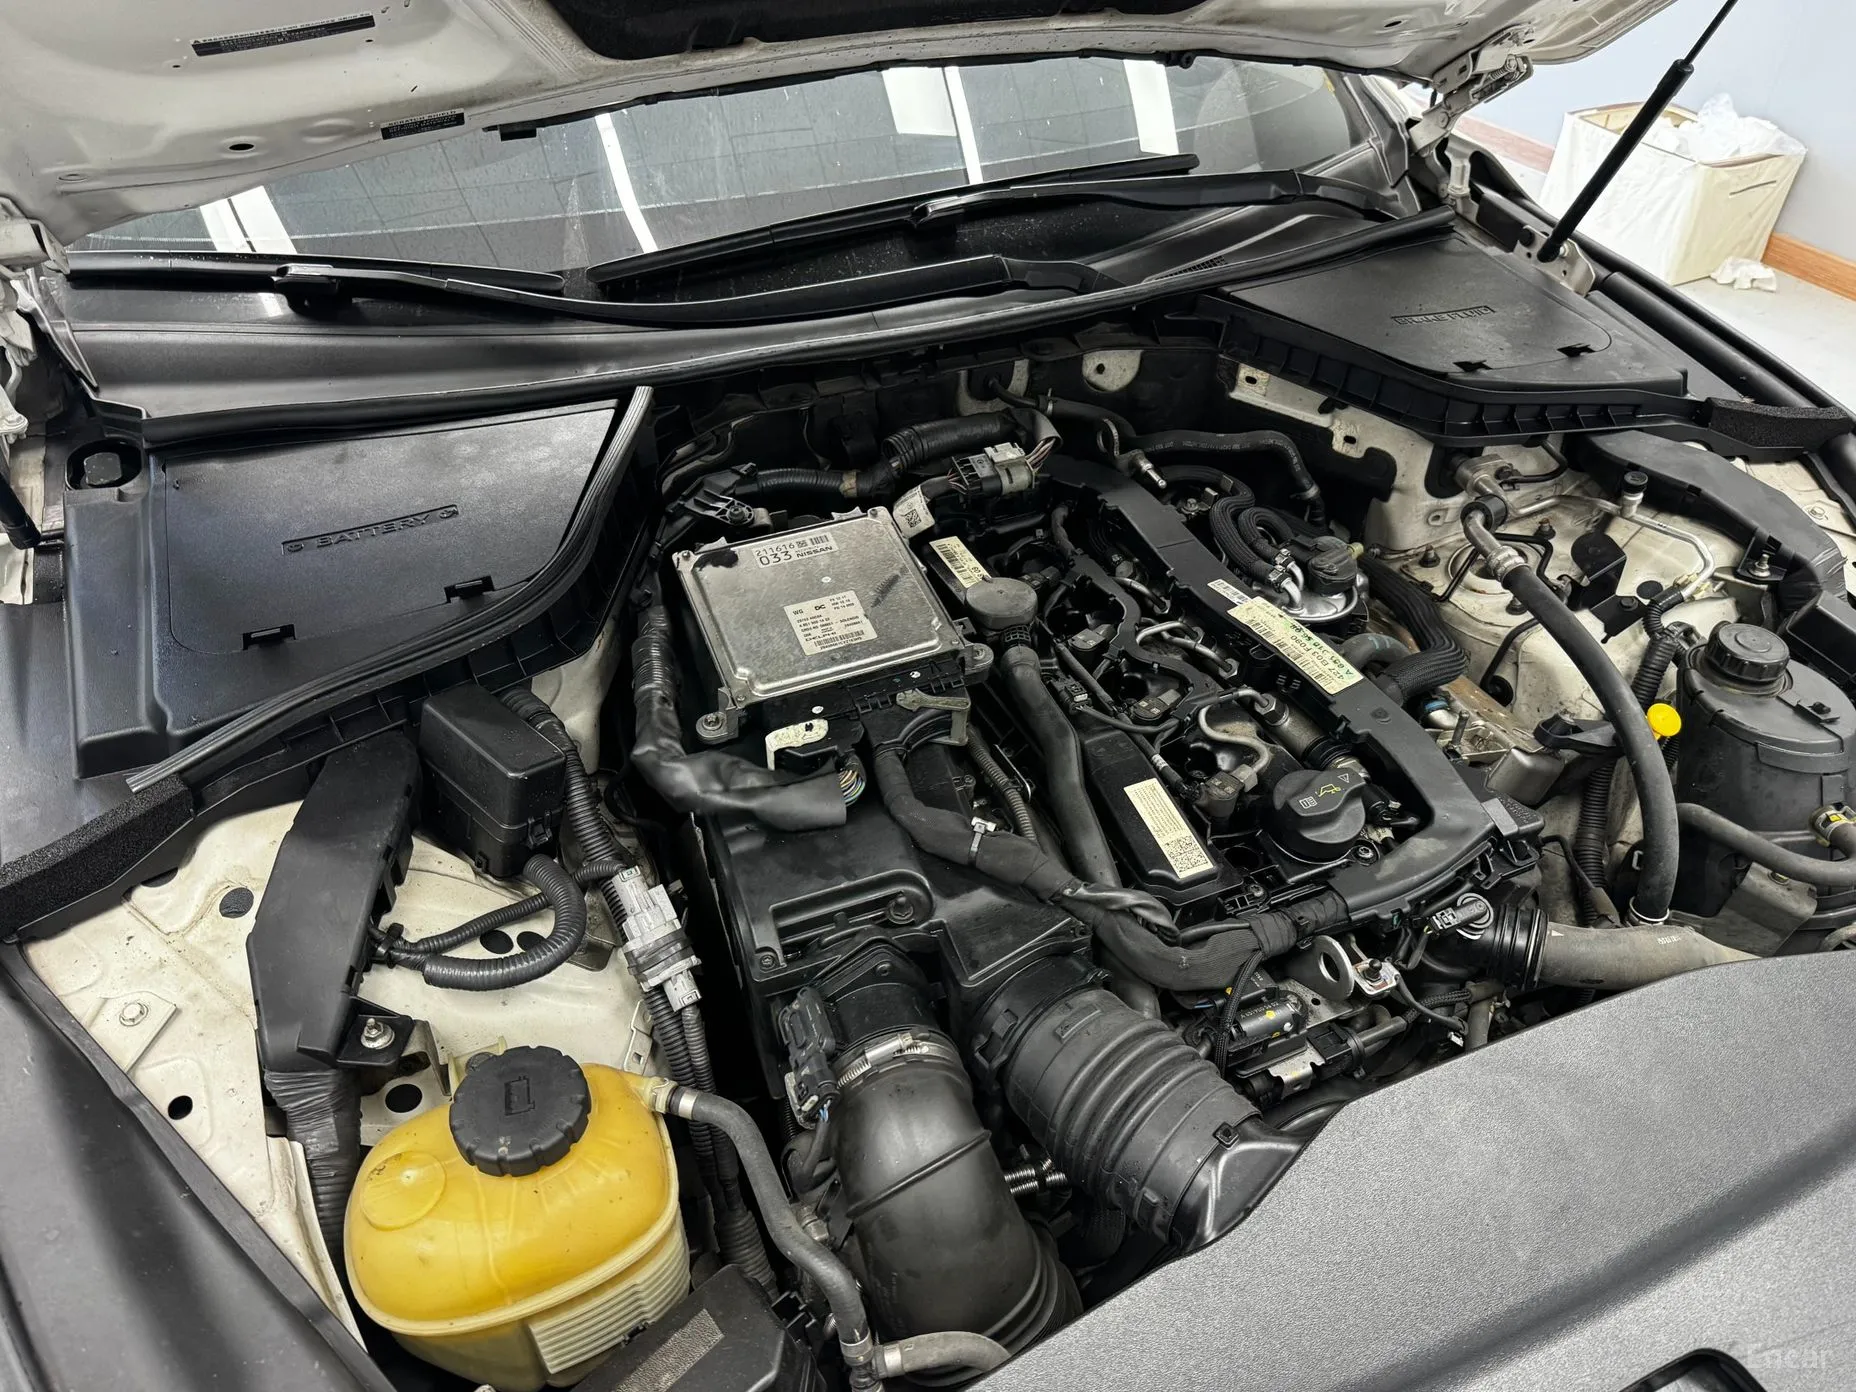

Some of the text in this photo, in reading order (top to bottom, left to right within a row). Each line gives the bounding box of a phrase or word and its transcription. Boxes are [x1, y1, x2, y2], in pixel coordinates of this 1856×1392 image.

[316, 514, 430, 548] BATTERY
[755, 542, 795, 557] 211616
[796, 545, 833, 558] NISSAN
[759, 551, 792, 566] 033
